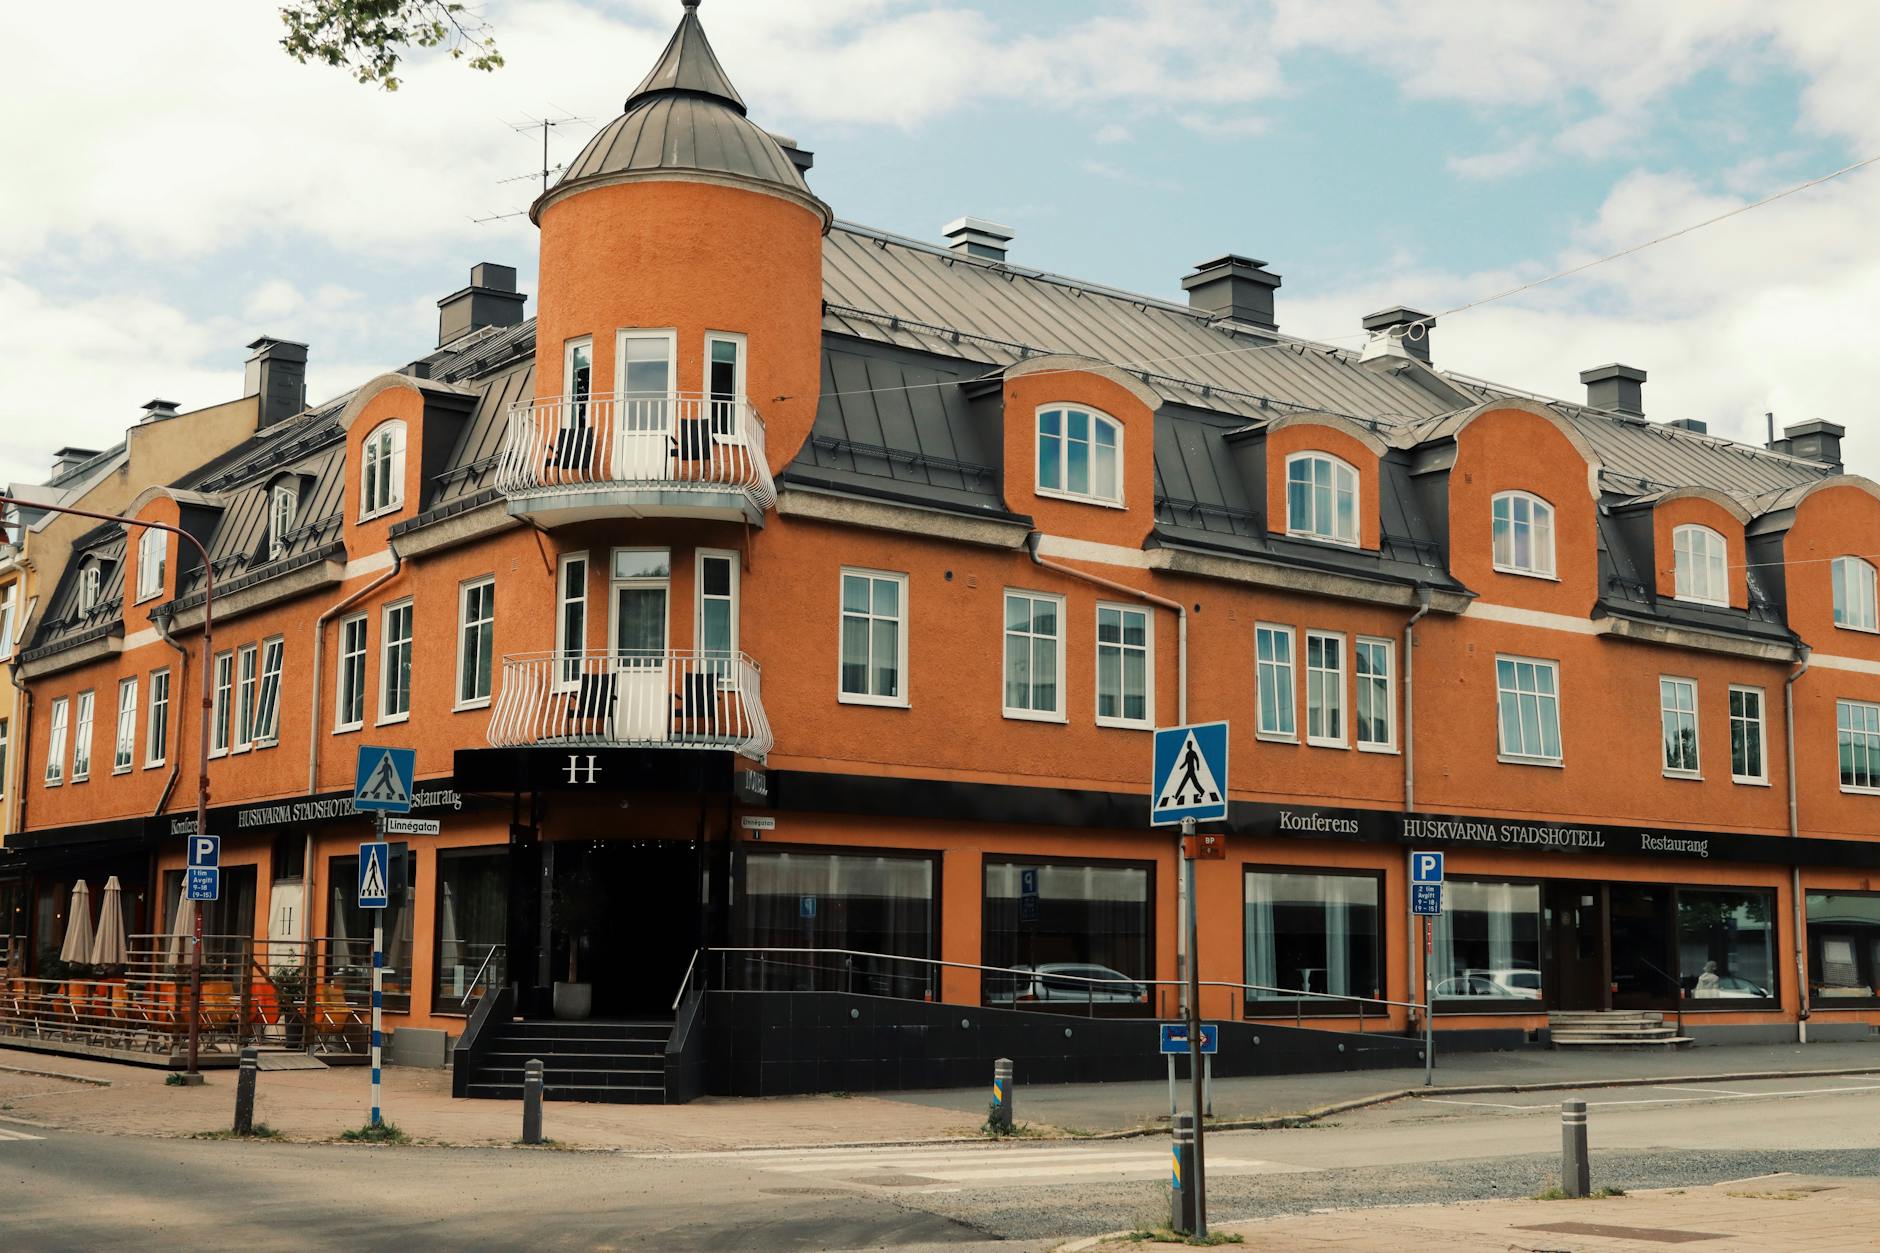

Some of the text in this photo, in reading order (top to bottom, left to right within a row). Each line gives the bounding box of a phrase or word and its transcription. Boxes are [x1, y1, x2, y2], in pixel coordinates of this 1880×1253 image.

[562, 755, 602, 783] H
[411, 788, 462, 810] estaurang
[238, 797, 363, 827] HUSKVARNA STADSHOTEL
[1279, 811, 1359, 834] Konferens
[171, 816, 200, 835] Konfere
[389, 820, 438, 833] Linnégatan
[1403, 819, 1606, 848] HUSKVARNA STADSHOTELL
[196, 839, 214, 864] P
[1205, 836, 1215, 845] BP
[1641, 833, 1709, 858] Restaurang
[1421, 856, 1436, 880] P
[193, 877, 213, 885] Avgift
